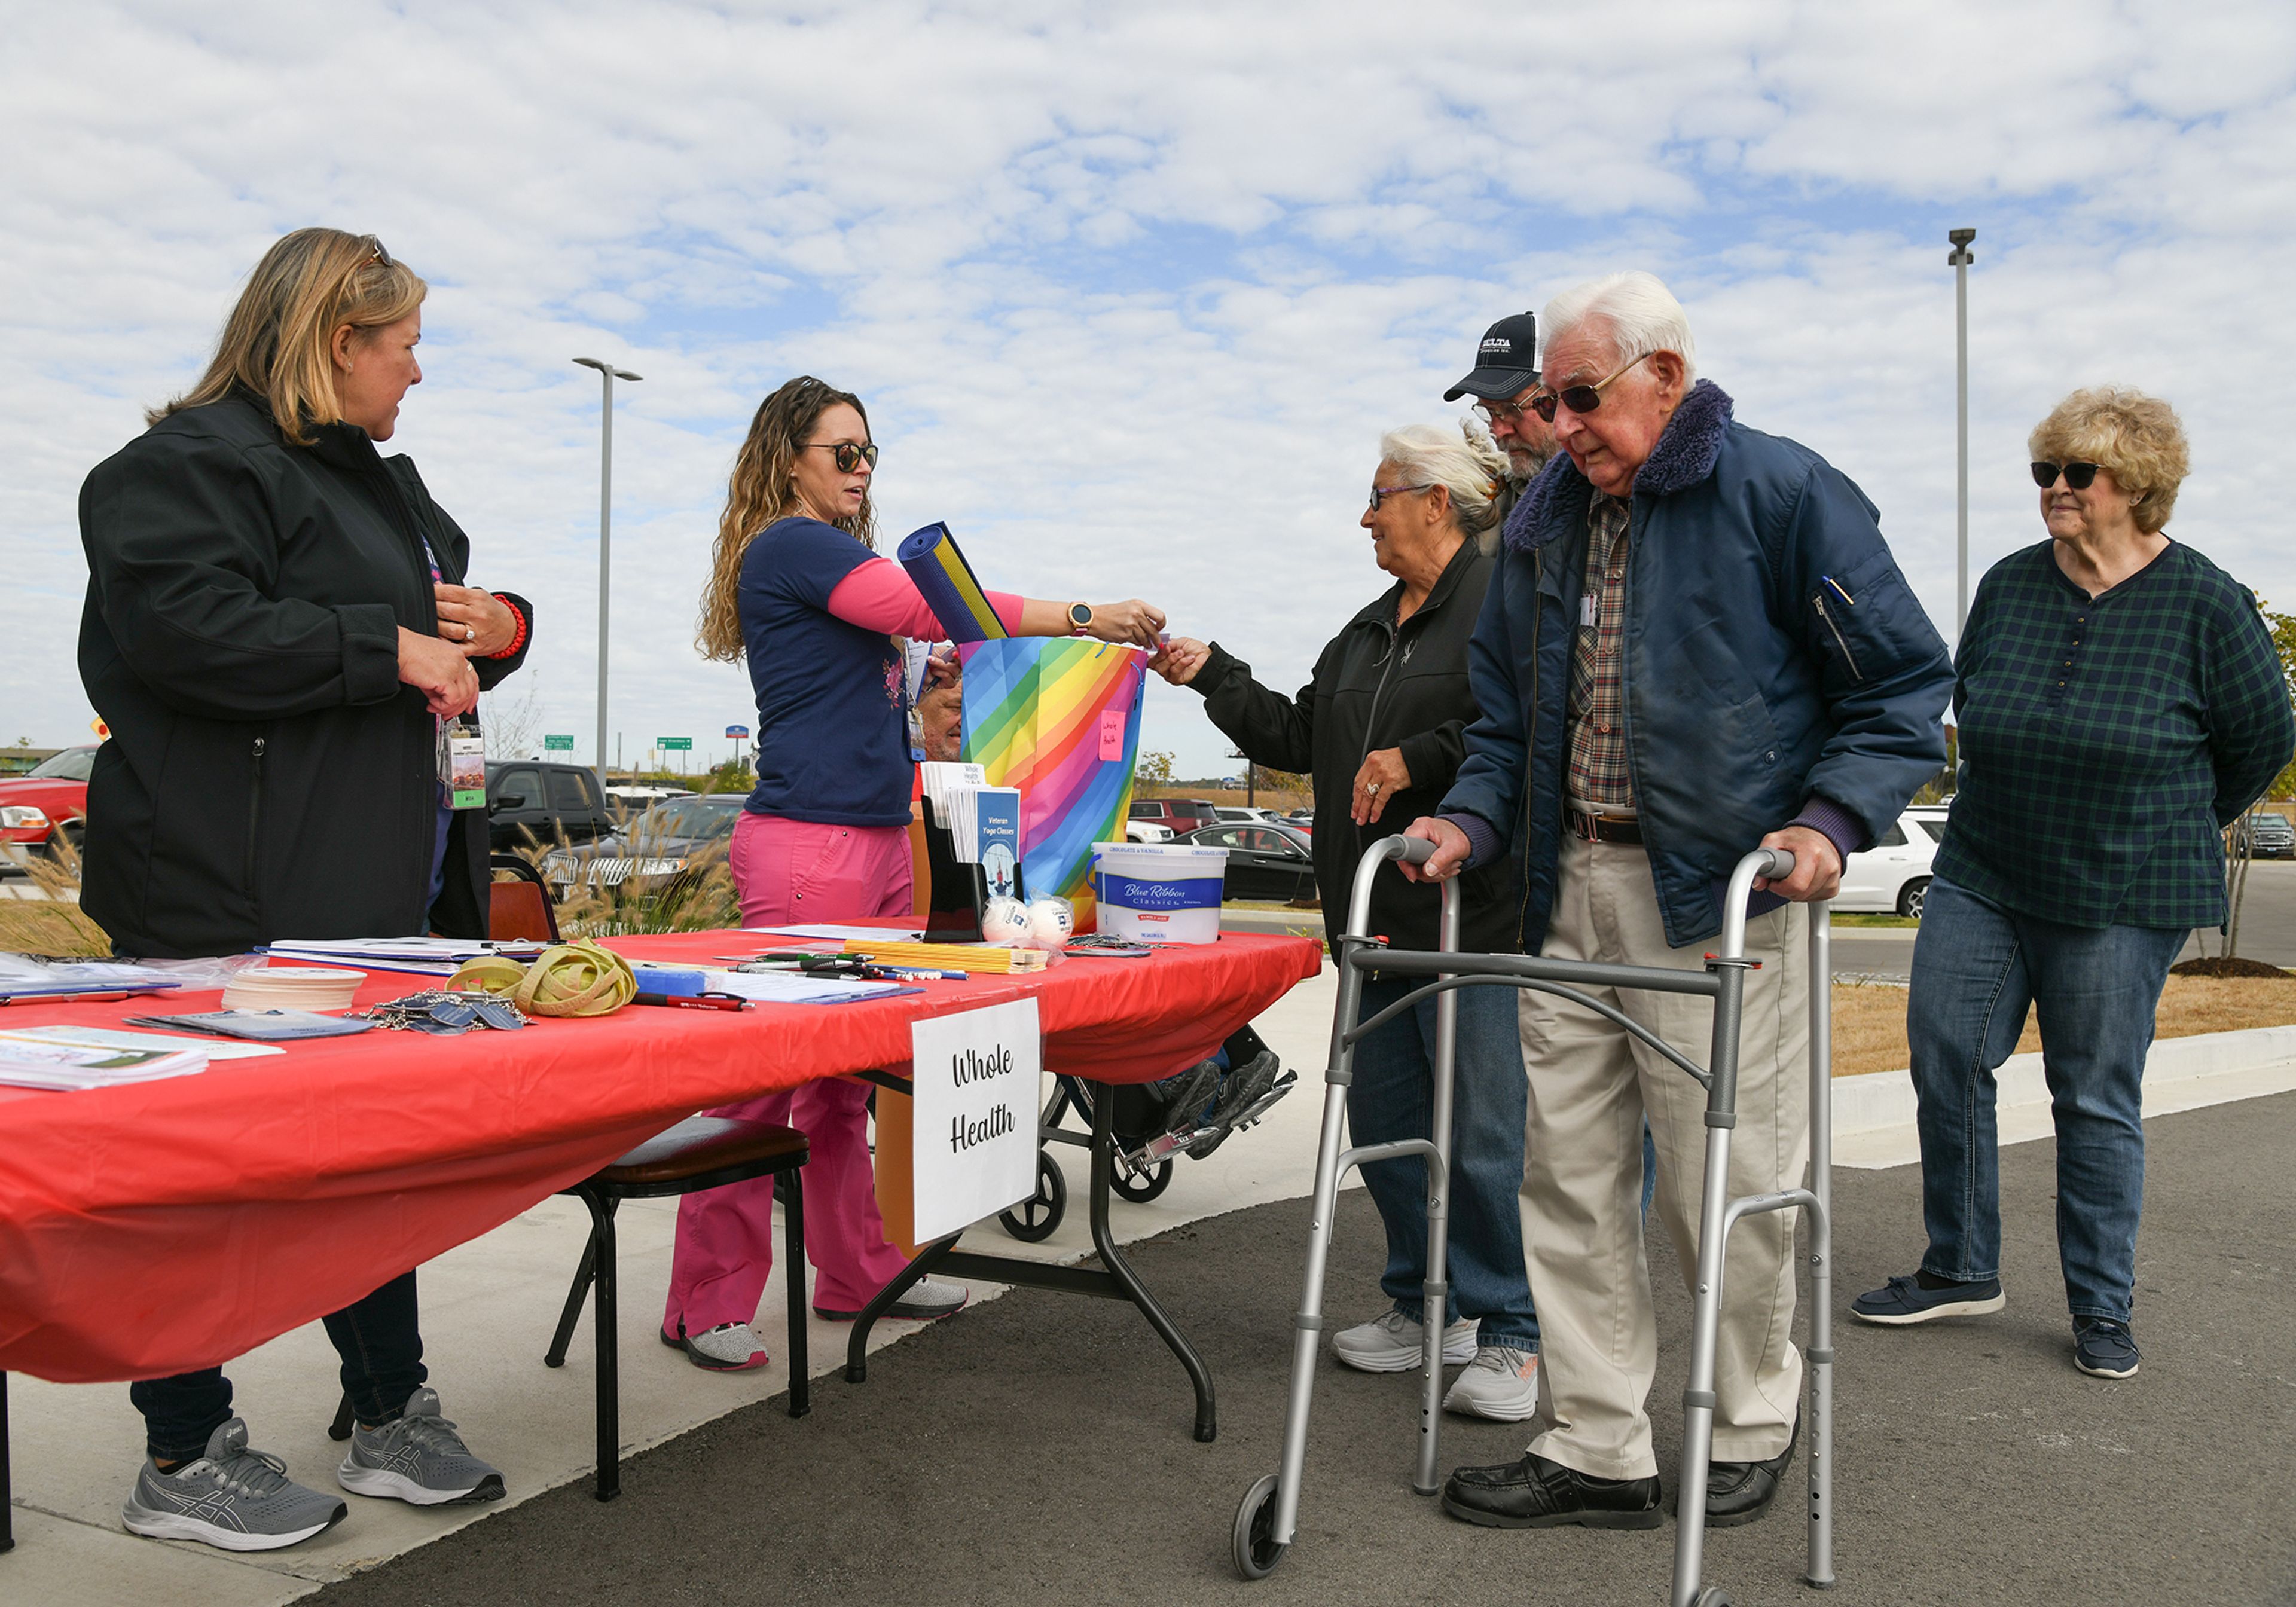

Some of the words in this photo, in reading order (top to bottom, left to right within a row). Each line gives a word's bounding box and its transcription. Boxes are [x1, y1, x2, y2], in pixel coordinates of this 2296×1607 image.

[983, 827, 996, 836] Yoga
[1125, 884, 1148, 896] Blue
[1150, 885, 1185, 898] Ribbon
[952, 1043, 1014, 1088] Whole
[950, 1103, 1016, 1153] Health
